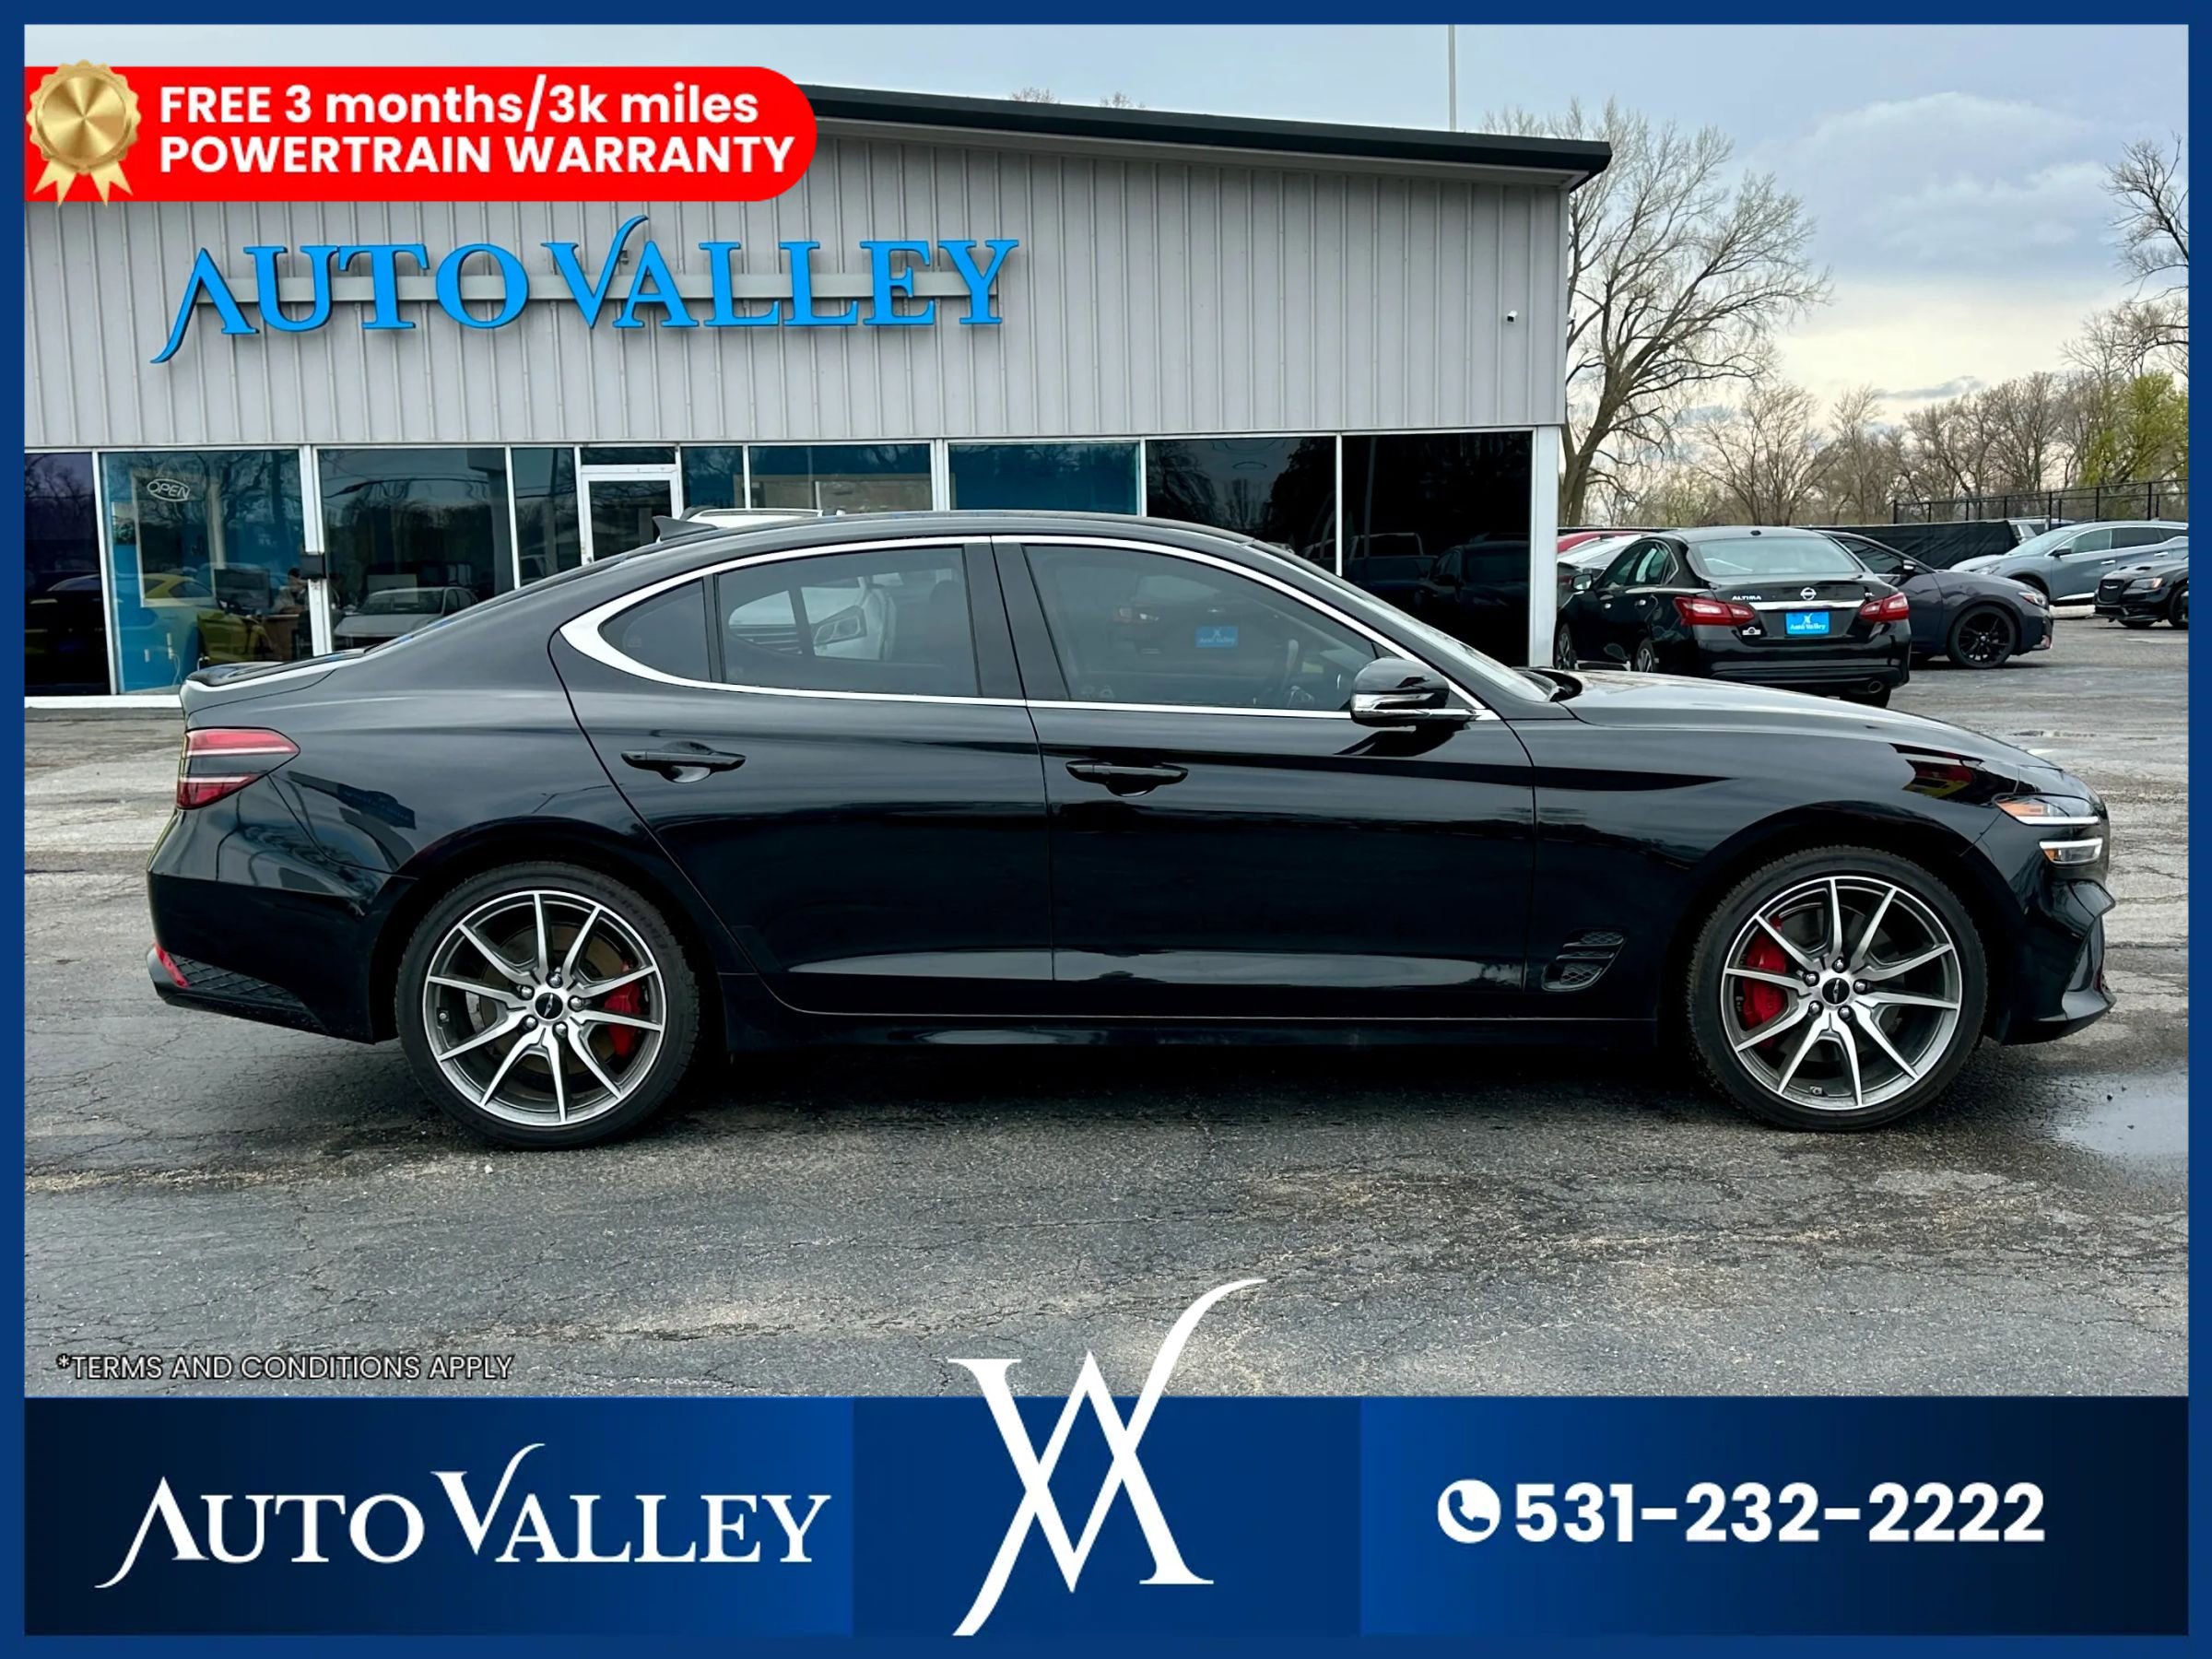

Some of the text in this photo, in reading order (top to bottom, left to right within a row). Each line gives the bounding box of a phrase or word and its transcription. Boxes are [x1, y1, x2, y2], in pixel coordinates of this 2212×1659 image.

[150, 214, 1018, 364] AUTO VALLEY
[147, 481, 190, 500] OPEN
